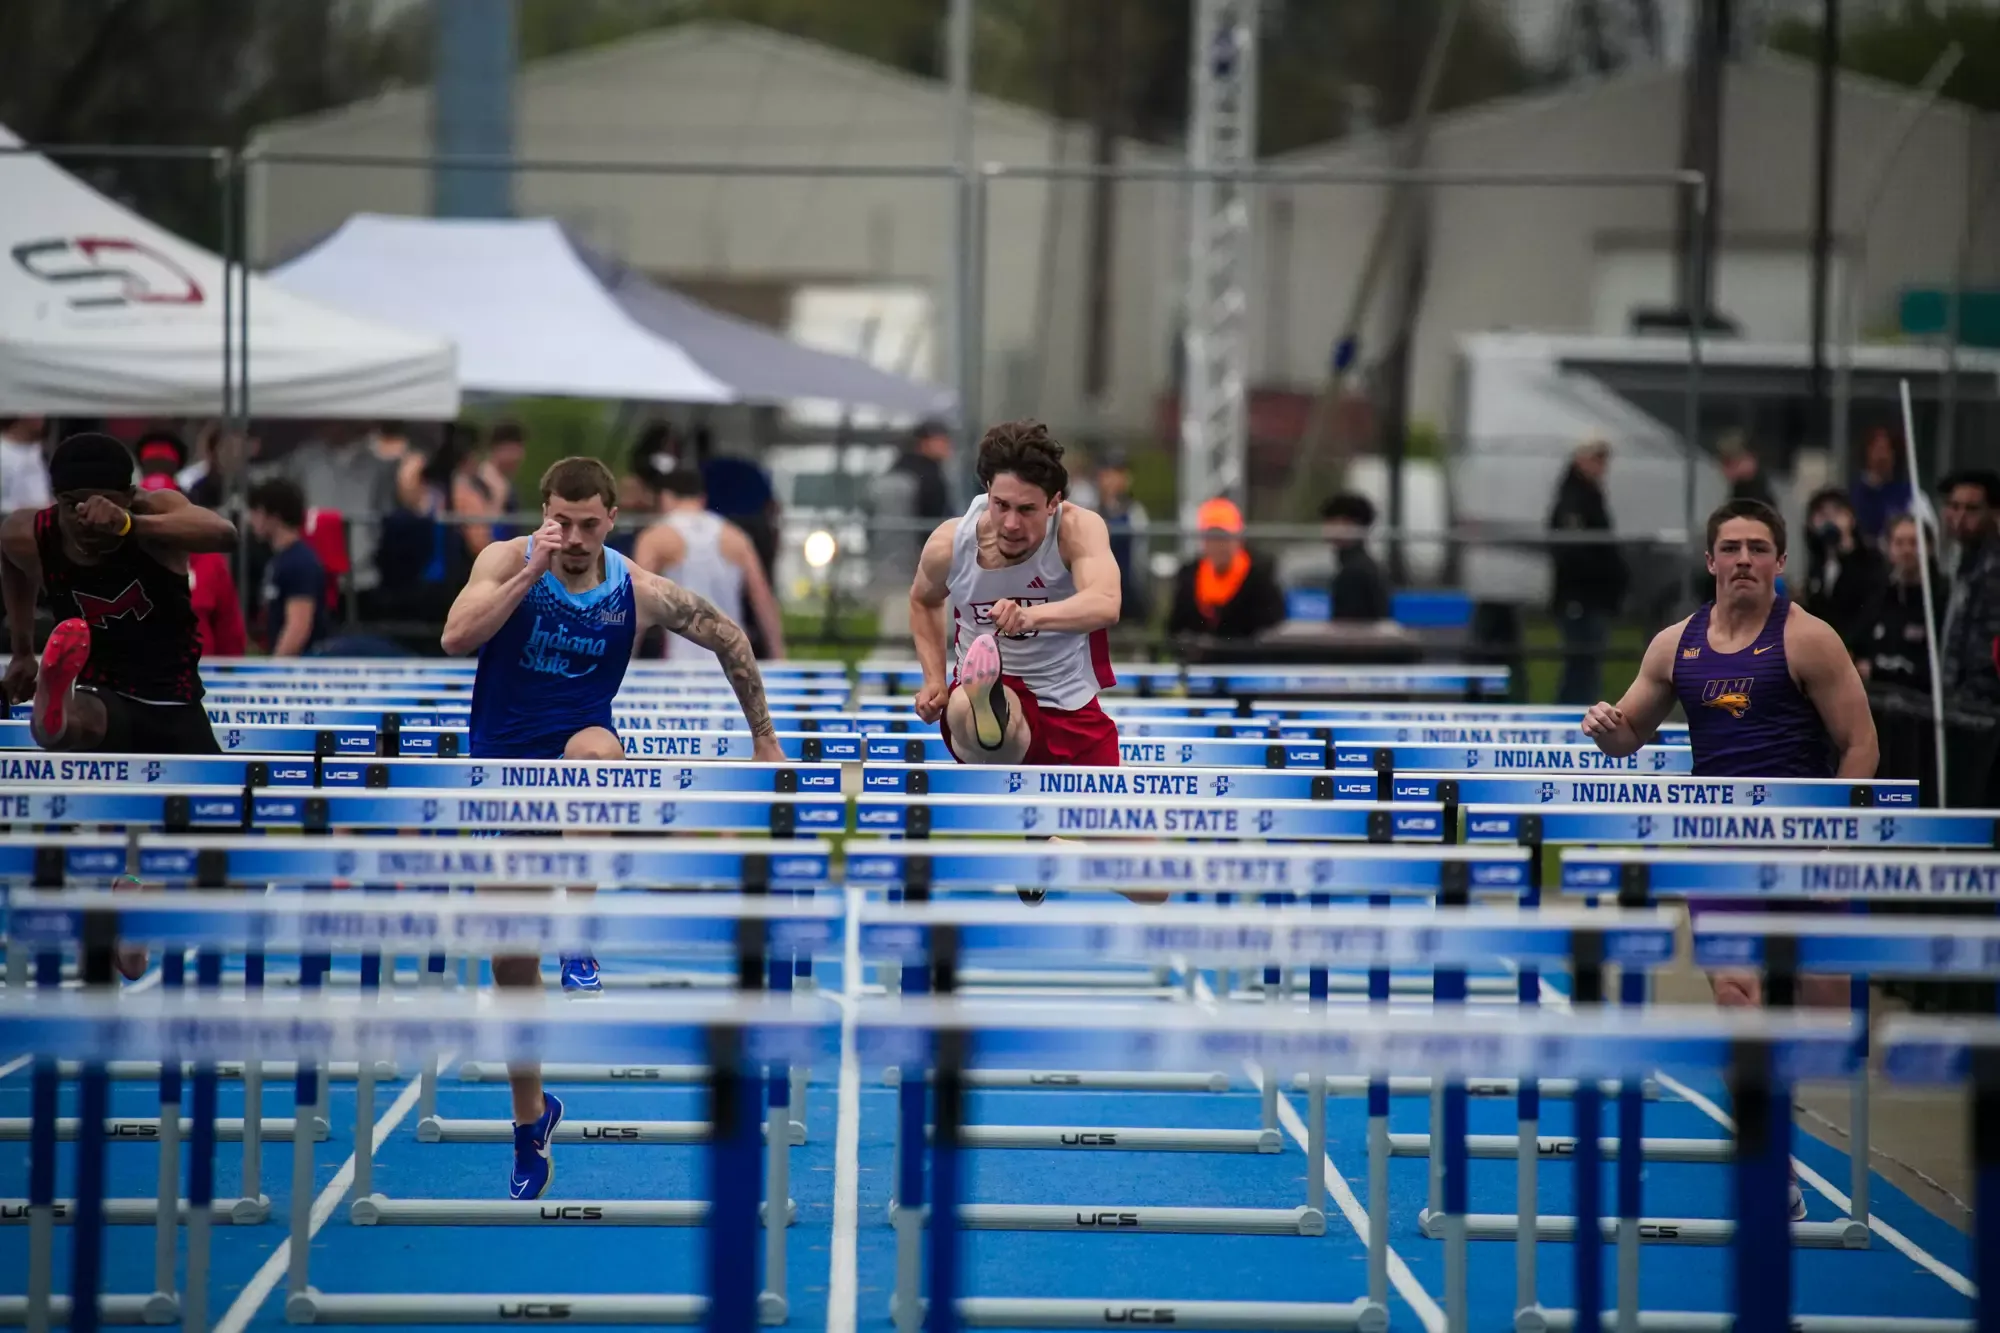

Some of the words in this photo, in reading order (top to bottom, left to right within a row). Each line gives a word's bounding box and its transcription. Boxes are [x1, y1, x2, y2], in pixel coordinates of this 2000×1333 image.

[526, 615, 607, 657] Indiana
[519, 645, 597, 678] State
[1702, 677, 1755, 703] UNI
[340, 737, 370, 746] UCS
[402, 738, 432, 747] UCS
[643, 736, 701, 754] STATE
[825, 745, 856, 754] UCS
[869, 745, 899, 754] UCS
[1119, 744, 1165, 761] TATE
[1290, 752, 1320, 761] UCS
[1338, 753, 1368, 762] UCS
[1494, 750, 1574, 768] INDIANA
[0, 759, 56, 780] IANA
[60, 760, 129, 781] STATE
[273, 769, 308, 779] UCS
[325, 770, 359, 780] UCS
[501, 766, 591, 787] INDIANA
[596, 768, 661, 788] STATE
[802, 776, 835, 785] UCS
[866, 776, 899, 785] UCS
[1039, 773, 1128, 794] INDIANA
[1133, 774, 1198, 795] STATE
[1338, 784, 1371, 793] UCS
[1397, 787, 1430, 796] UCS
[1572, 783, 1662, 804] INDIANA
[1667, 784, 1734, 804] STATE
[1878, 793, 1912, 802] UCS
[458, 800, 559, 823] INDIANA
[566, 802, 641, 825] STATE
[1058, 807, 1158, 830] INDIANA
[1163, 809, 1239, 832] STATE
[1673, 816, 1775, 840] INDIANA
[1782, 816, 1859, 841] STATE
[1929, 864, 2000, 893] STAT
[610, 1069, 660, 1079] UCS
[1029, 1074, 1081, 1085] UCS
[1469, 1085, 1509, 1096] CS
[583, 1127, 639, 1139] UCS
[1061, 1133, 1117, 1146] UCS
[1537, 1142, 1576, 1155] UC
[540, 1207, 603, 1220] UCS
[1076, 1213, 1138, 1226] UCS
[1616, 1223, 1680, 1238] CS
[498, 1304, 572, 1319] UCS
[1104, 1307, 1176, 1323] UCS
